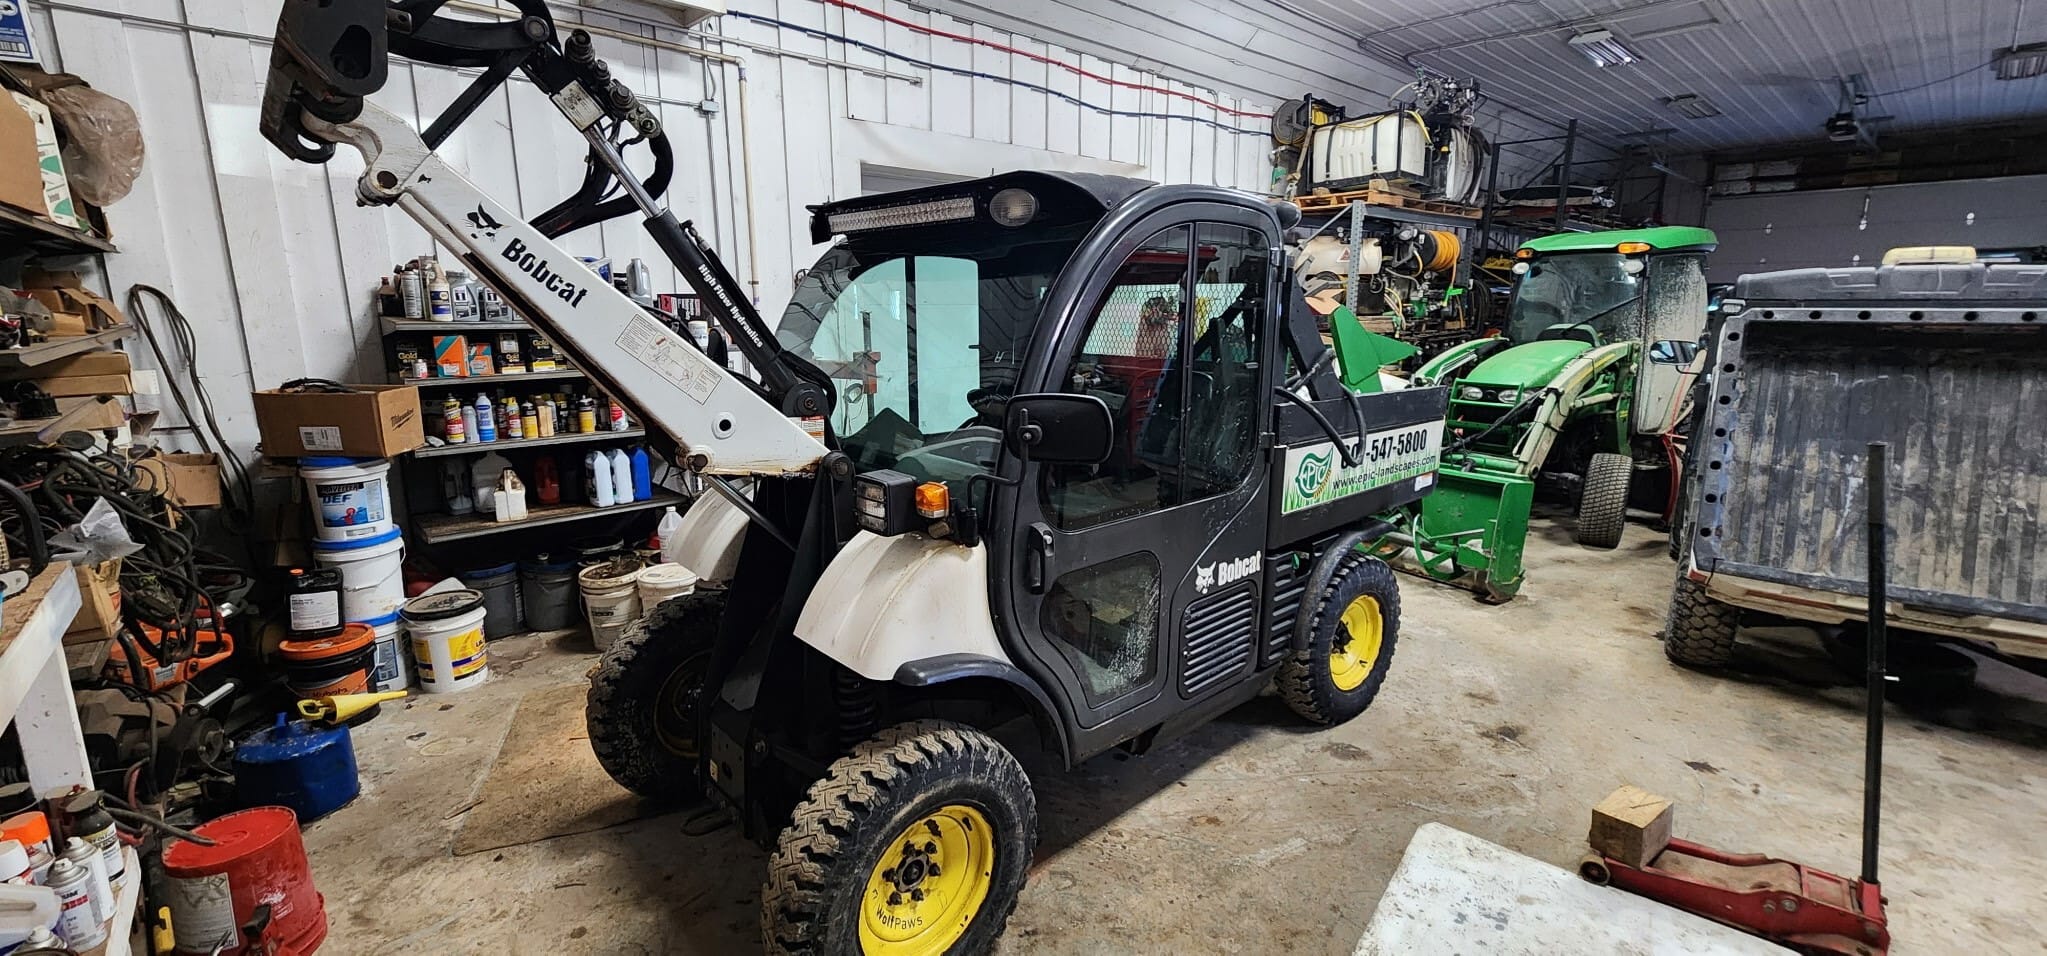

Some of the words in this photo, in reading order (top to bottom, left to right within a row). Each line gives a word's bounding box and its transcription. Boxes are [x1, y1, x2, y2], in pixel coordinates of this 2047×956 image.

[501, 237, 588, 308] Bobcat
[698, 263, 716, 287] High
[713, 284, 732, 307] Flow
[730, 306, 763, 348] Hydraulics
[398, 352, 418, 360] Gold
[1341, 429, 1428, 469] 0-547-5800
[1299, 460, 1327, 491] EPIC
[1332, 455, 1436, 490] www.epic-landscapes.com
[322, 493, 352, 504] DEF
[1218, 550, 1262, 586] Bobcat
[877, 903, 923, 930] WolfPaws
